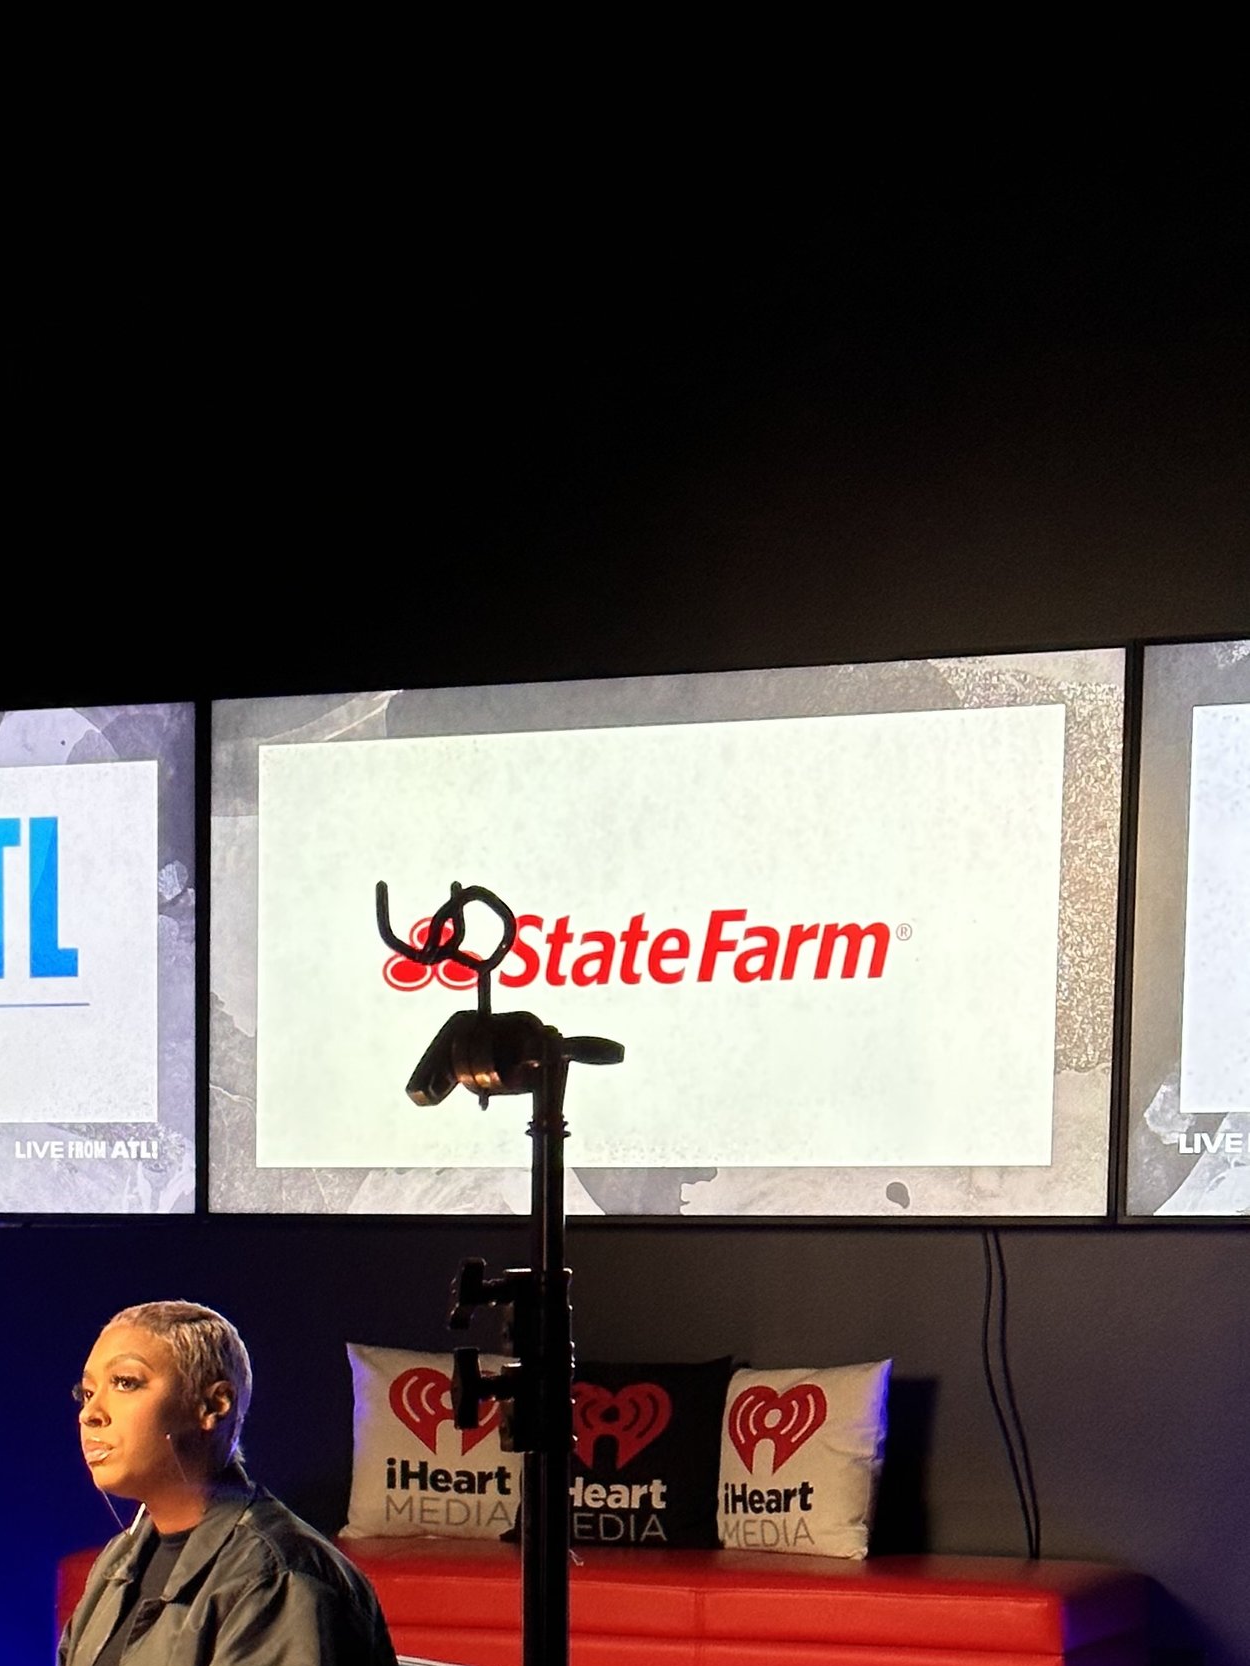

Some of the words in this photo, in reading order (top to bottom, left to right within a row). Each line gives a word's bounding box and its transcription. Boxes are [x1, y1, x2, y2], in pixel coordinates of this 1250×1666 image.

[15, 1141, 64, 1159] LIVE
[68, 1141, 106, 1159] FROM
[111, 1141, 159, 1159] ATL!
[1179, 1133, 1243, 1154] LIVE
[386, 1457, 512, 1496] iHeart
[385, 1495, 512, 1528] MEDIA
[724, 1481, 814, 1514] iHeart
[574, 1512, 668, 1542] EDIA
[719, 1517, 815, 1548] MEDIA
